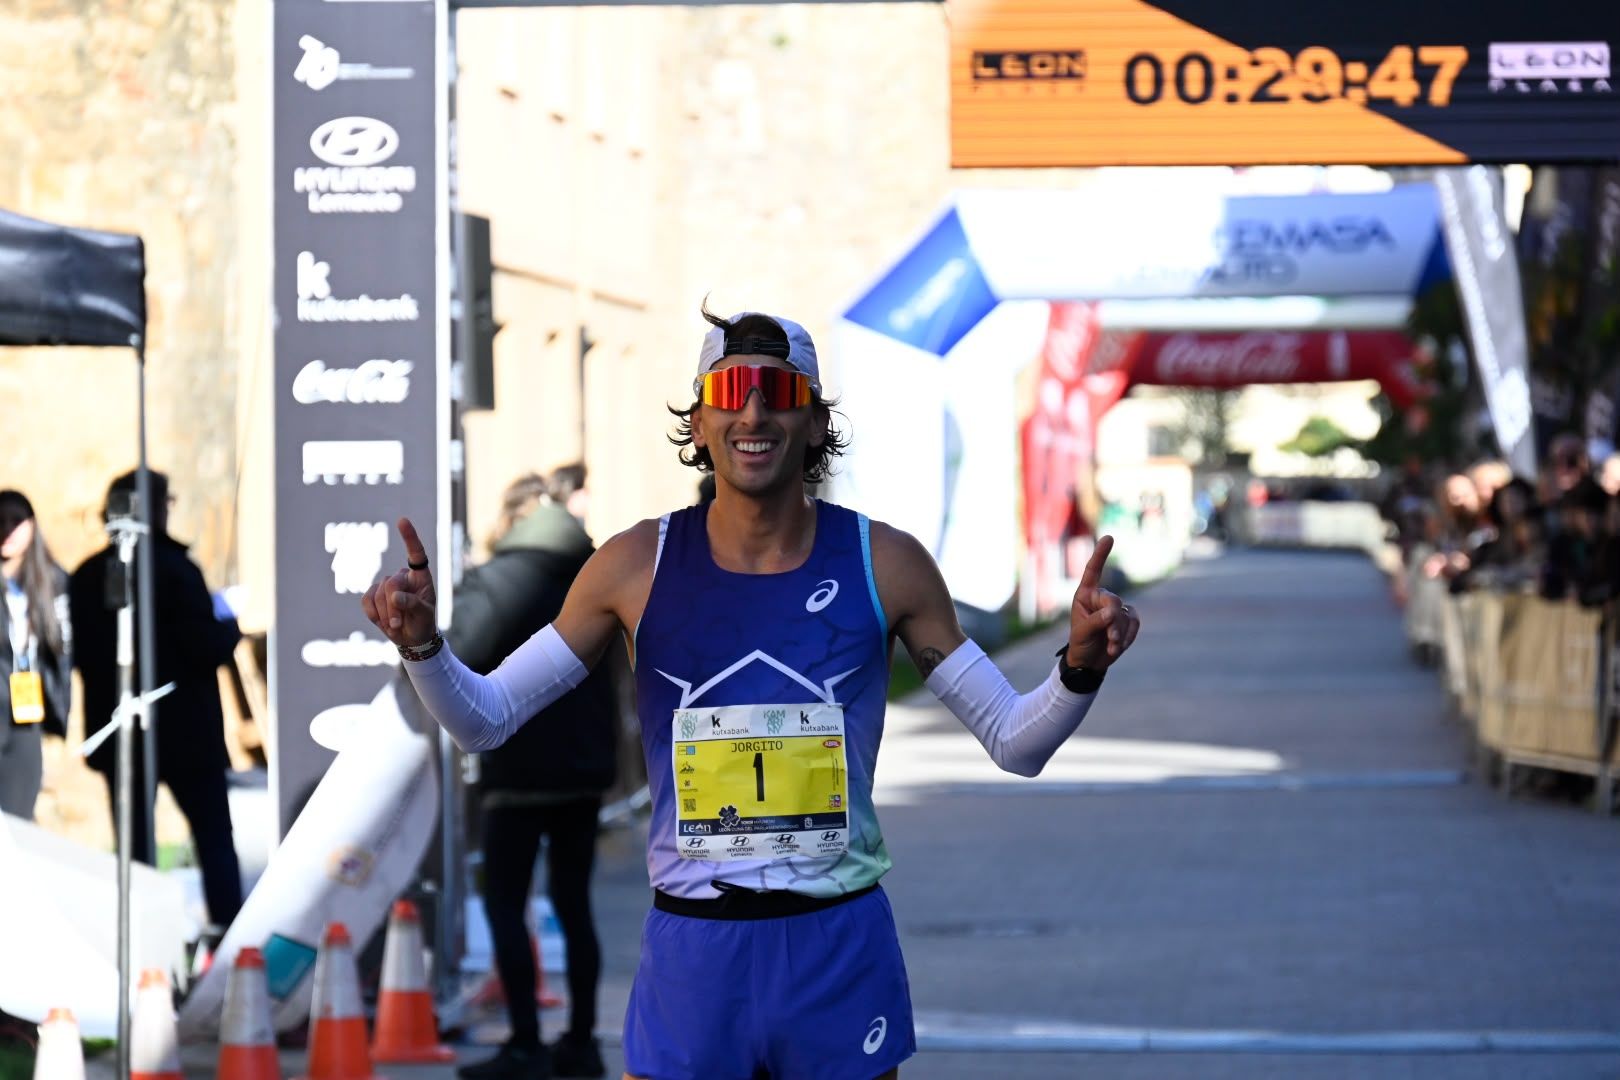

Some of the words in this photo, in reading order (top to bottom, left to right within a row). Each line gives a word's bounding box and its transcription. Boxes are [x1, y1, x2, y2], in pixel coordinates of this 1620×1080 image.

[974, 51, 1086, 79] LEON
[1125, 45, 1468, 106] 00:29:47
[294, 166, 416, 193] HYUNDAI
[1155, 335, 1303, 379] Coca-Cola
[712, 726, 750, 736] kutxabank
[800, 724, 840, 732] kutxabank
[730, 740, 783, 753] JORGITO
[753, 752, 765, 802] 1
